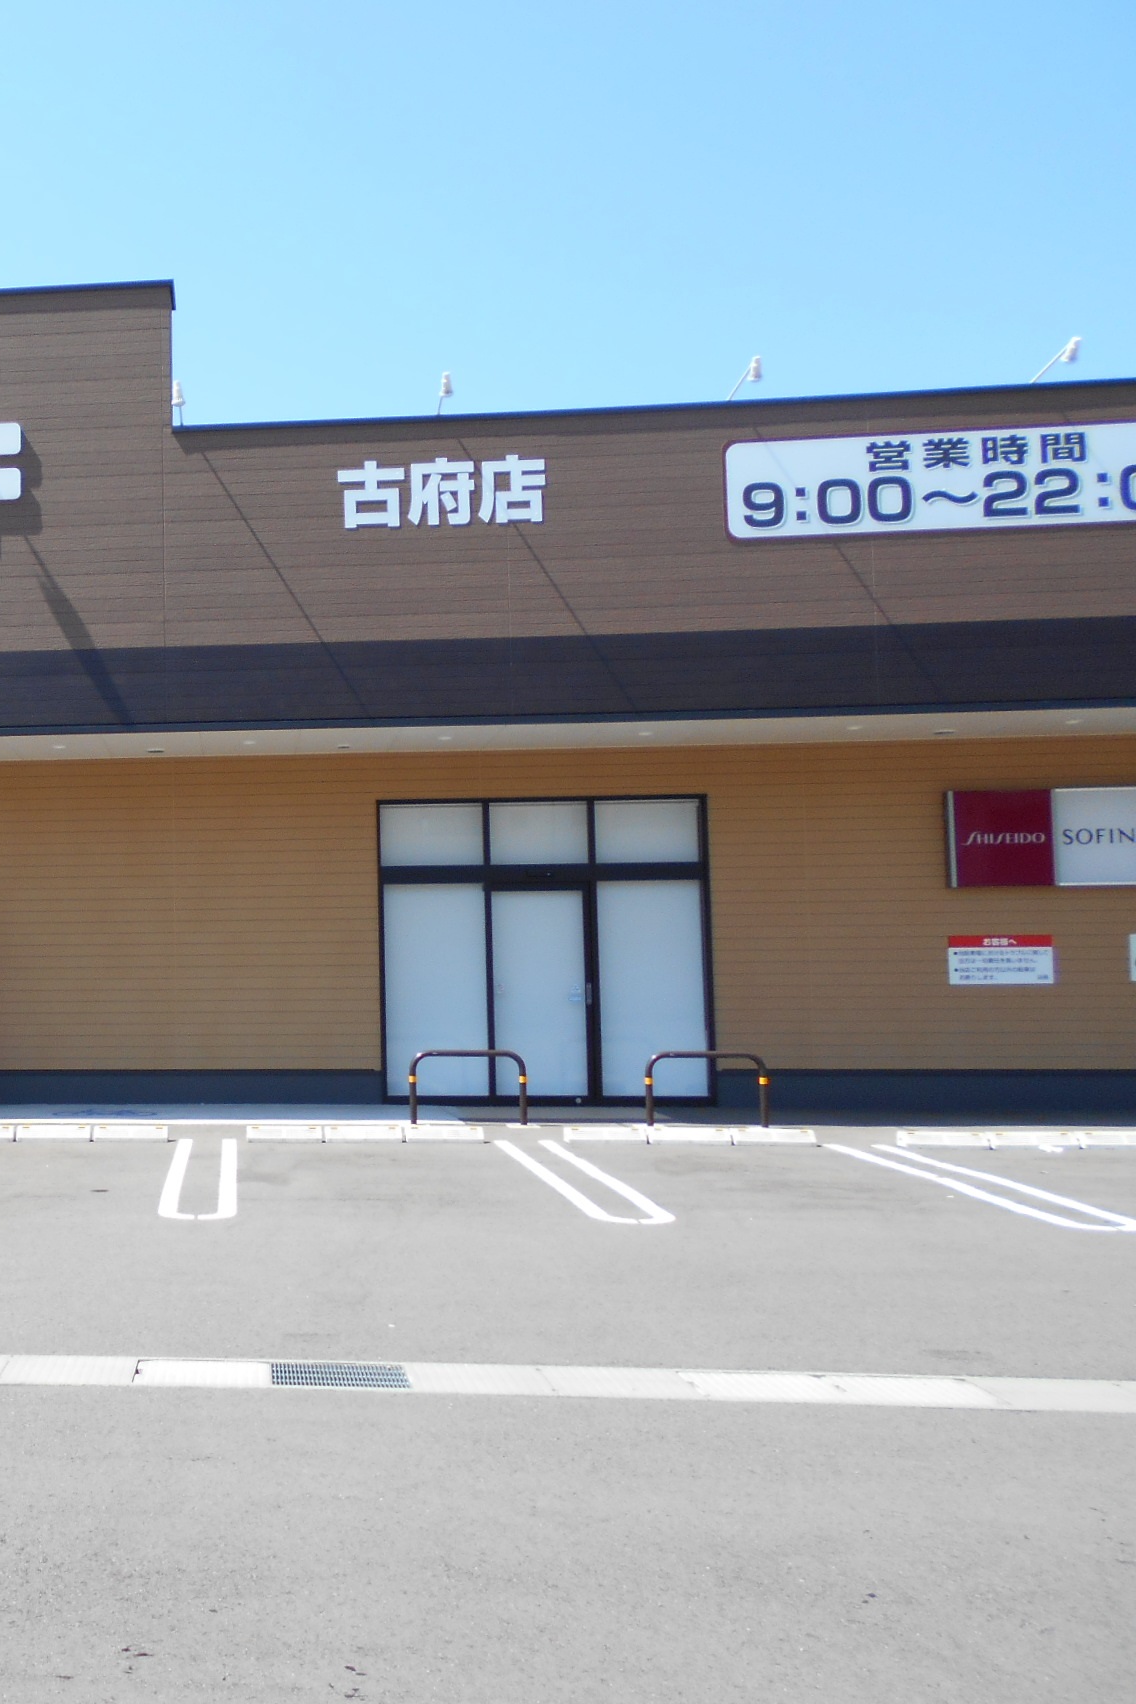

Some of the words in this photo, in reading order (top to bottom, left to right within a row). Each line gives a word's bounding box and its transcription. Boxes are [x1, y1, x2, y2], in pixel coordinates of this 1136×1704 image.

[866, 431, 1087, 473] 営業時間
[337, 454, 546, 529] 古府店
[962, 831, 1046, 846] SHISEIDO
